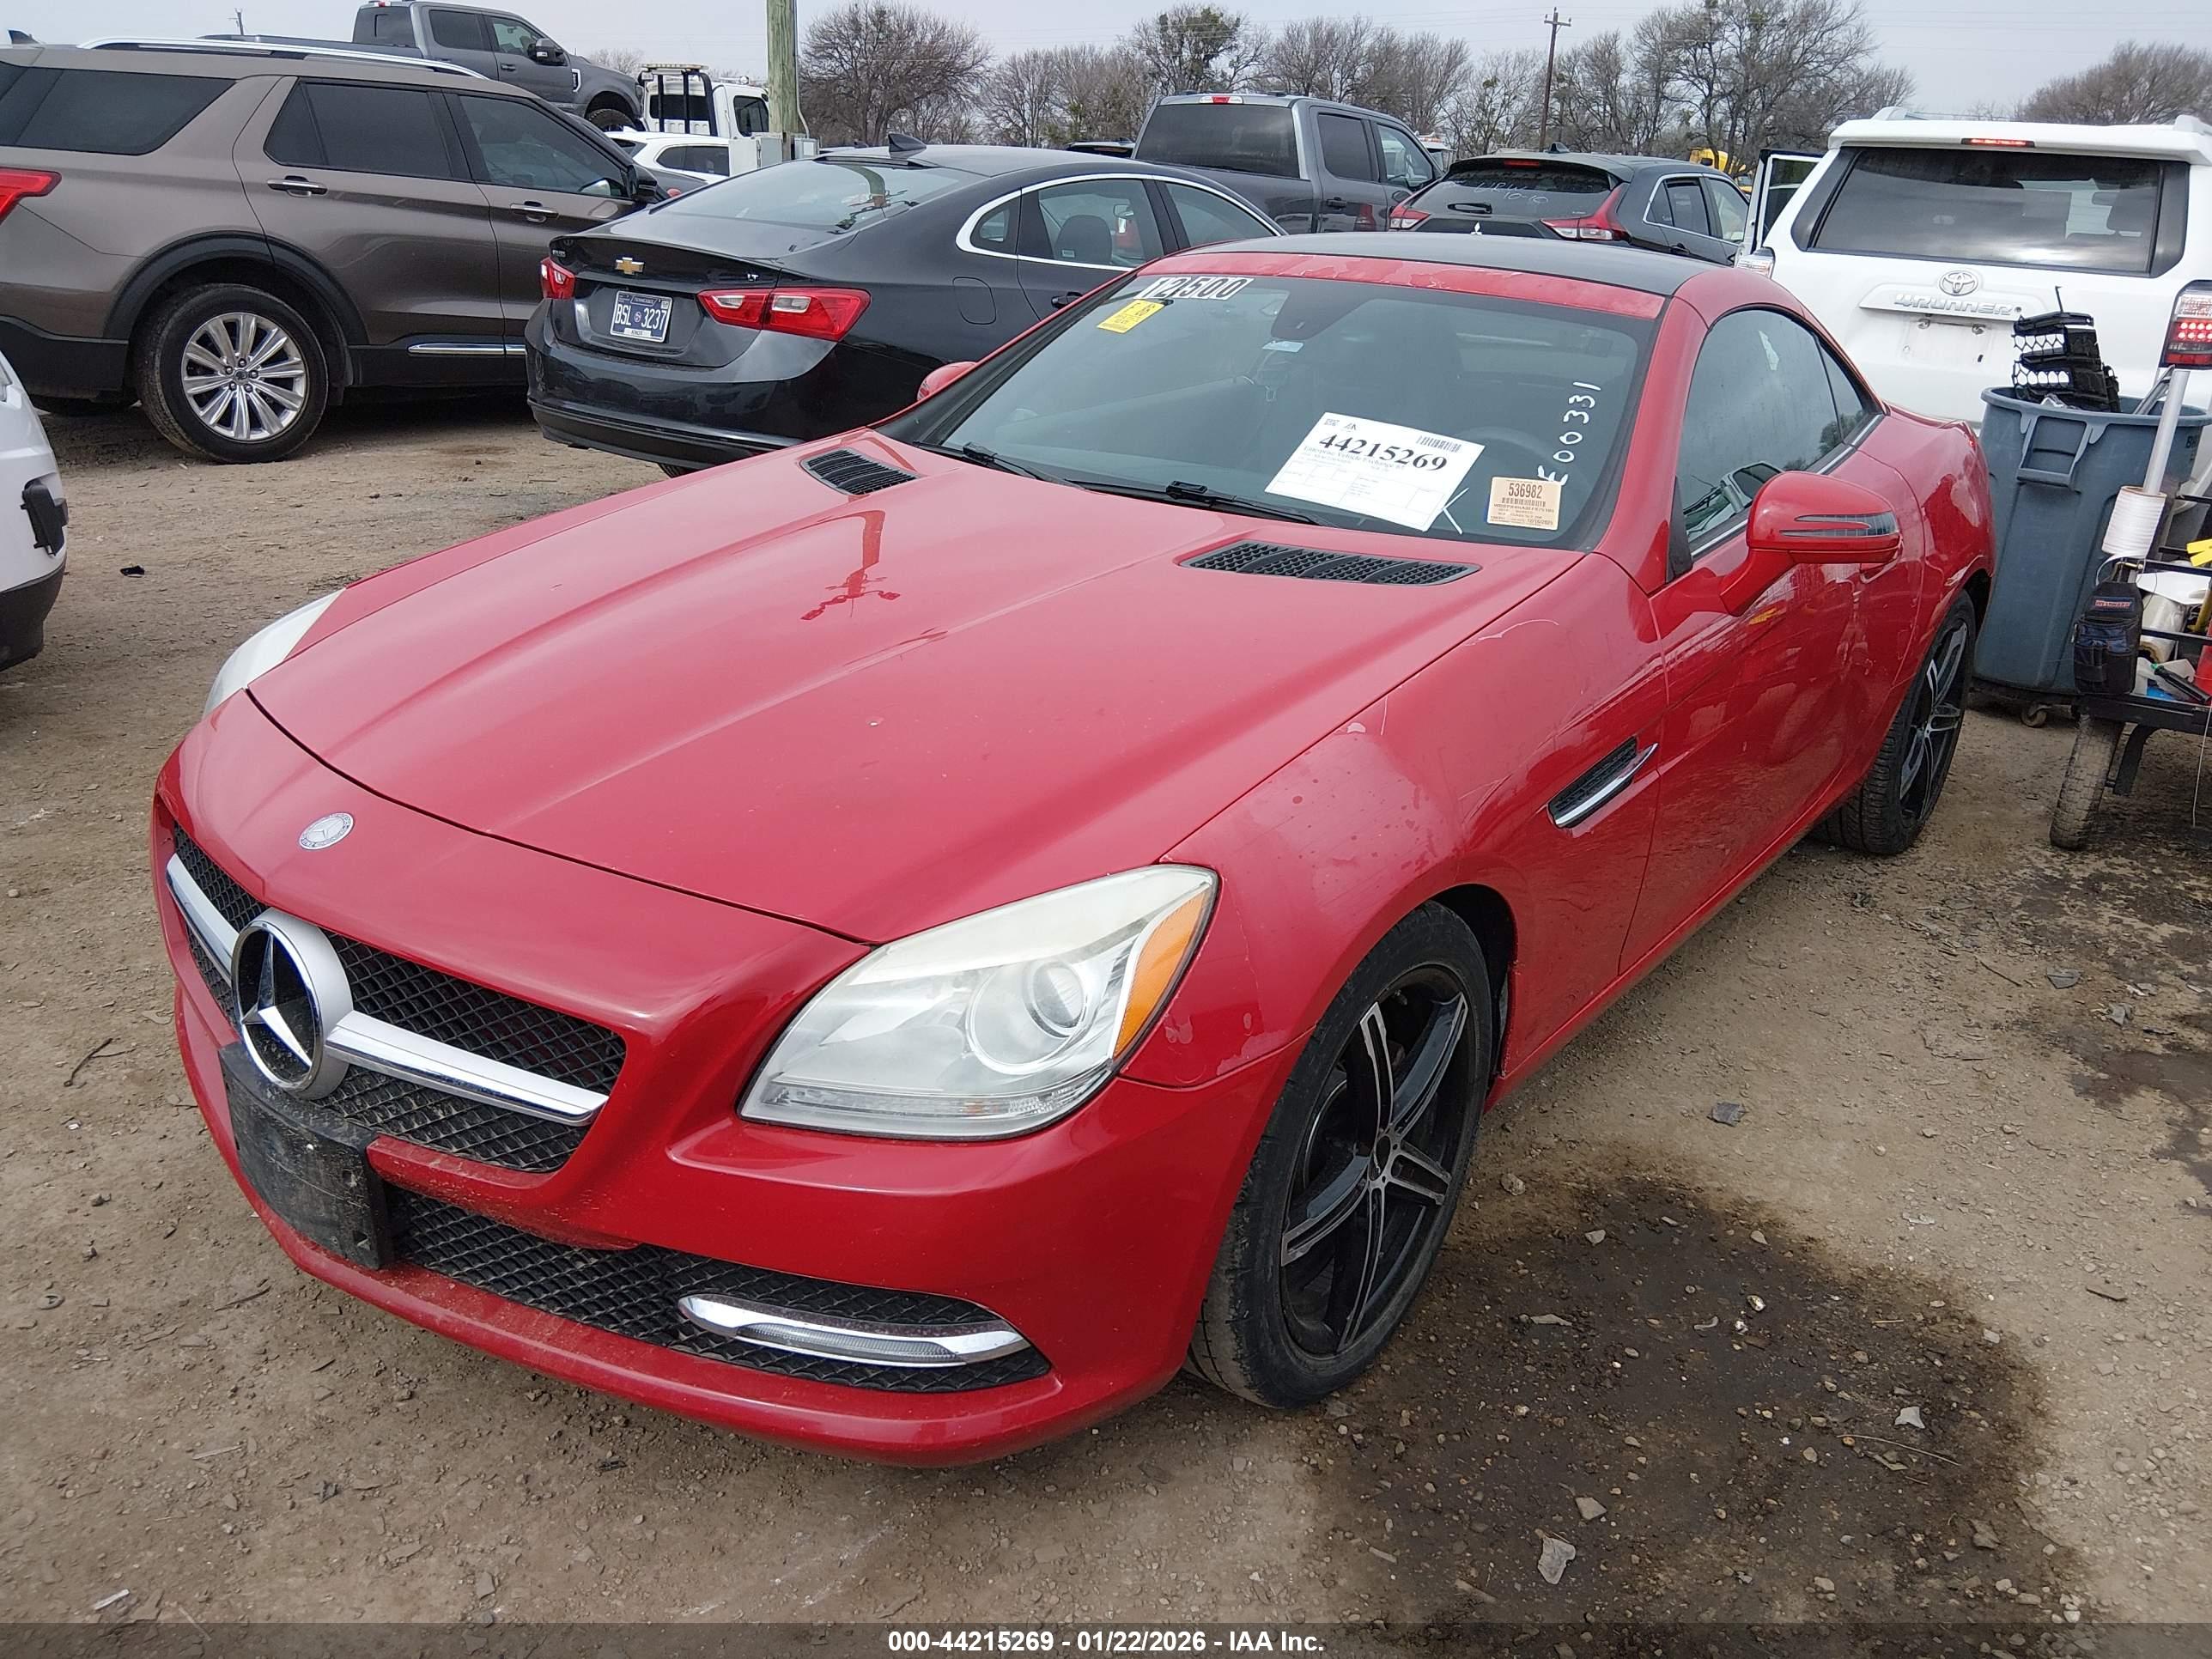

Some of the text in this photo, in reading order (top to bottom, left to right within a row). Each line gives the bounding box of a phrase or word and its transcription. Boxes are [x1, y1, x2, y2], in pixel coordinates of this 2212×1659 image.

[1143, 276, 1249, 300] 12500
[615, 303, 667, 331] BSL 3237
[1894, 294, 2013, 316] 4RUNNER
[1319, 434, 1448, 471] 44215269
[1508, 483, 1543, 500] 536982
